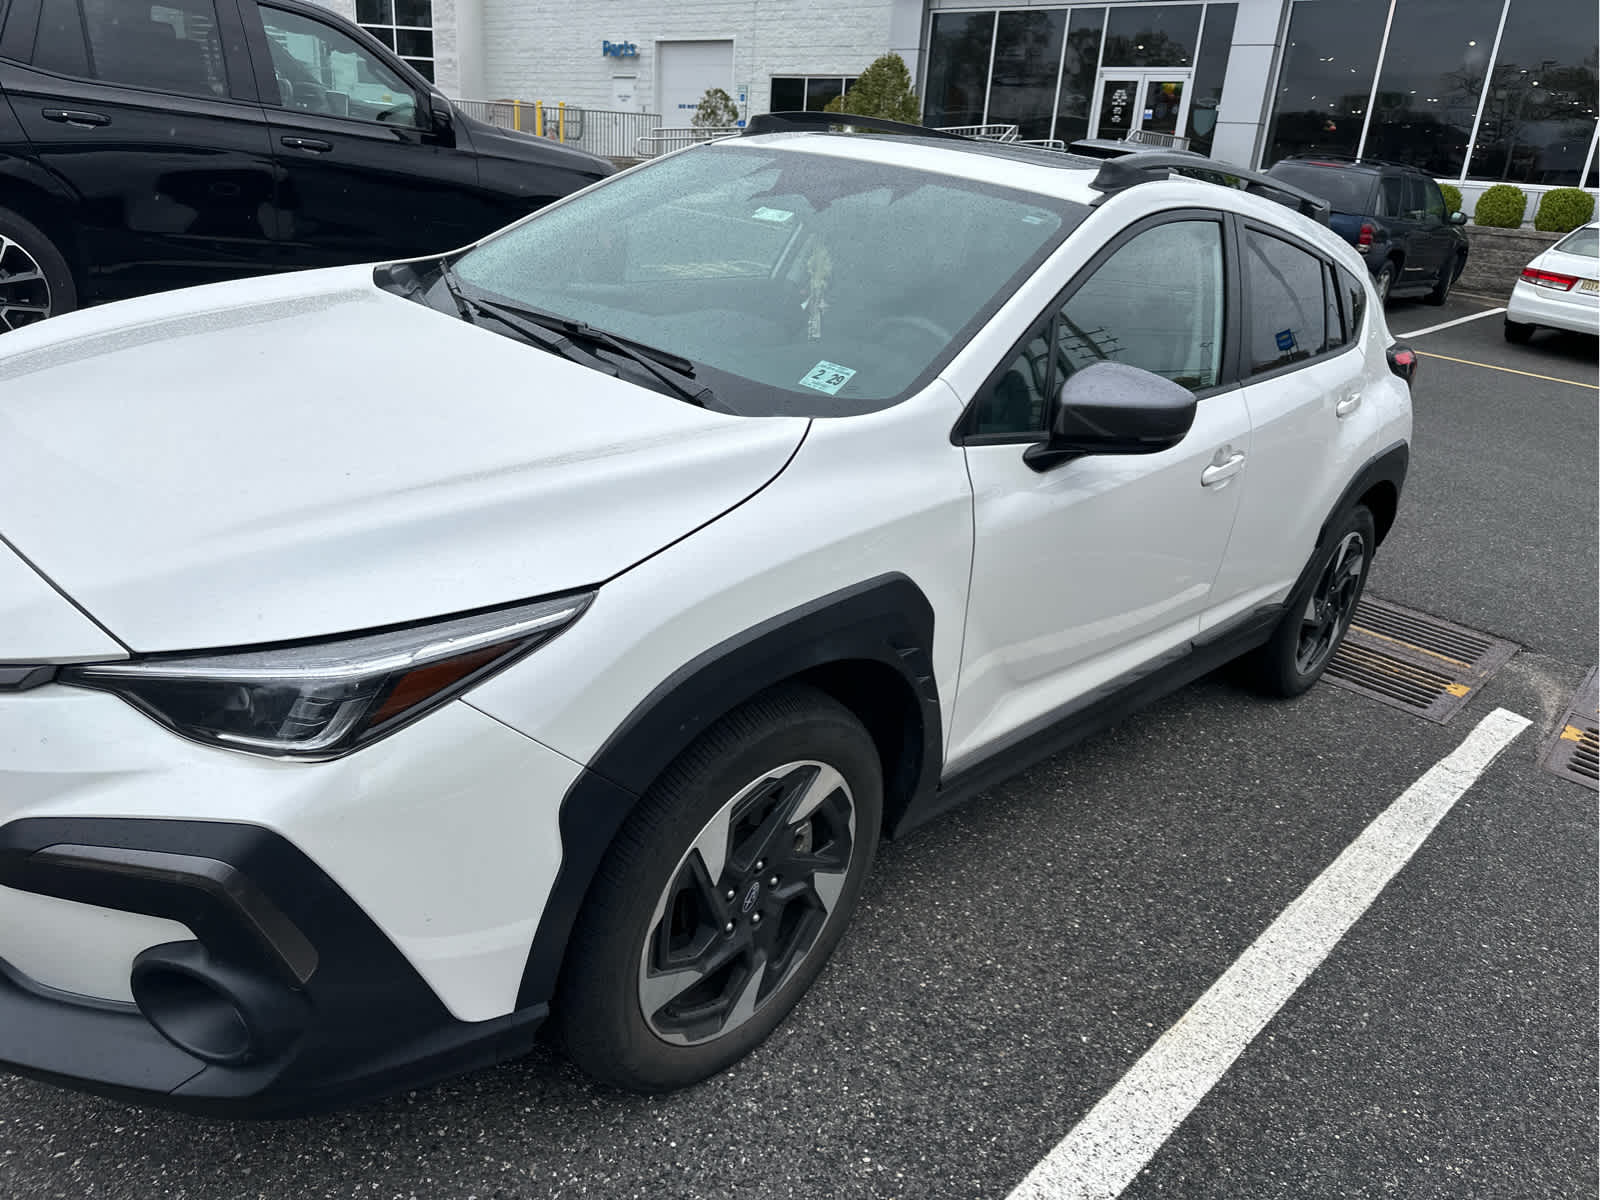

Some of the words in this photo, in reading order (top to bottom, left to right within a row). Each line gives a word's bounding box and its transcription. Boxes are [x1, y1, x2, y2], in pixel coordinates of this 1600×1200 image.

[602, 40, 637, 57] Parts
[811, 369, 826, 380] 2
[825, 373, 845, 386] 29
